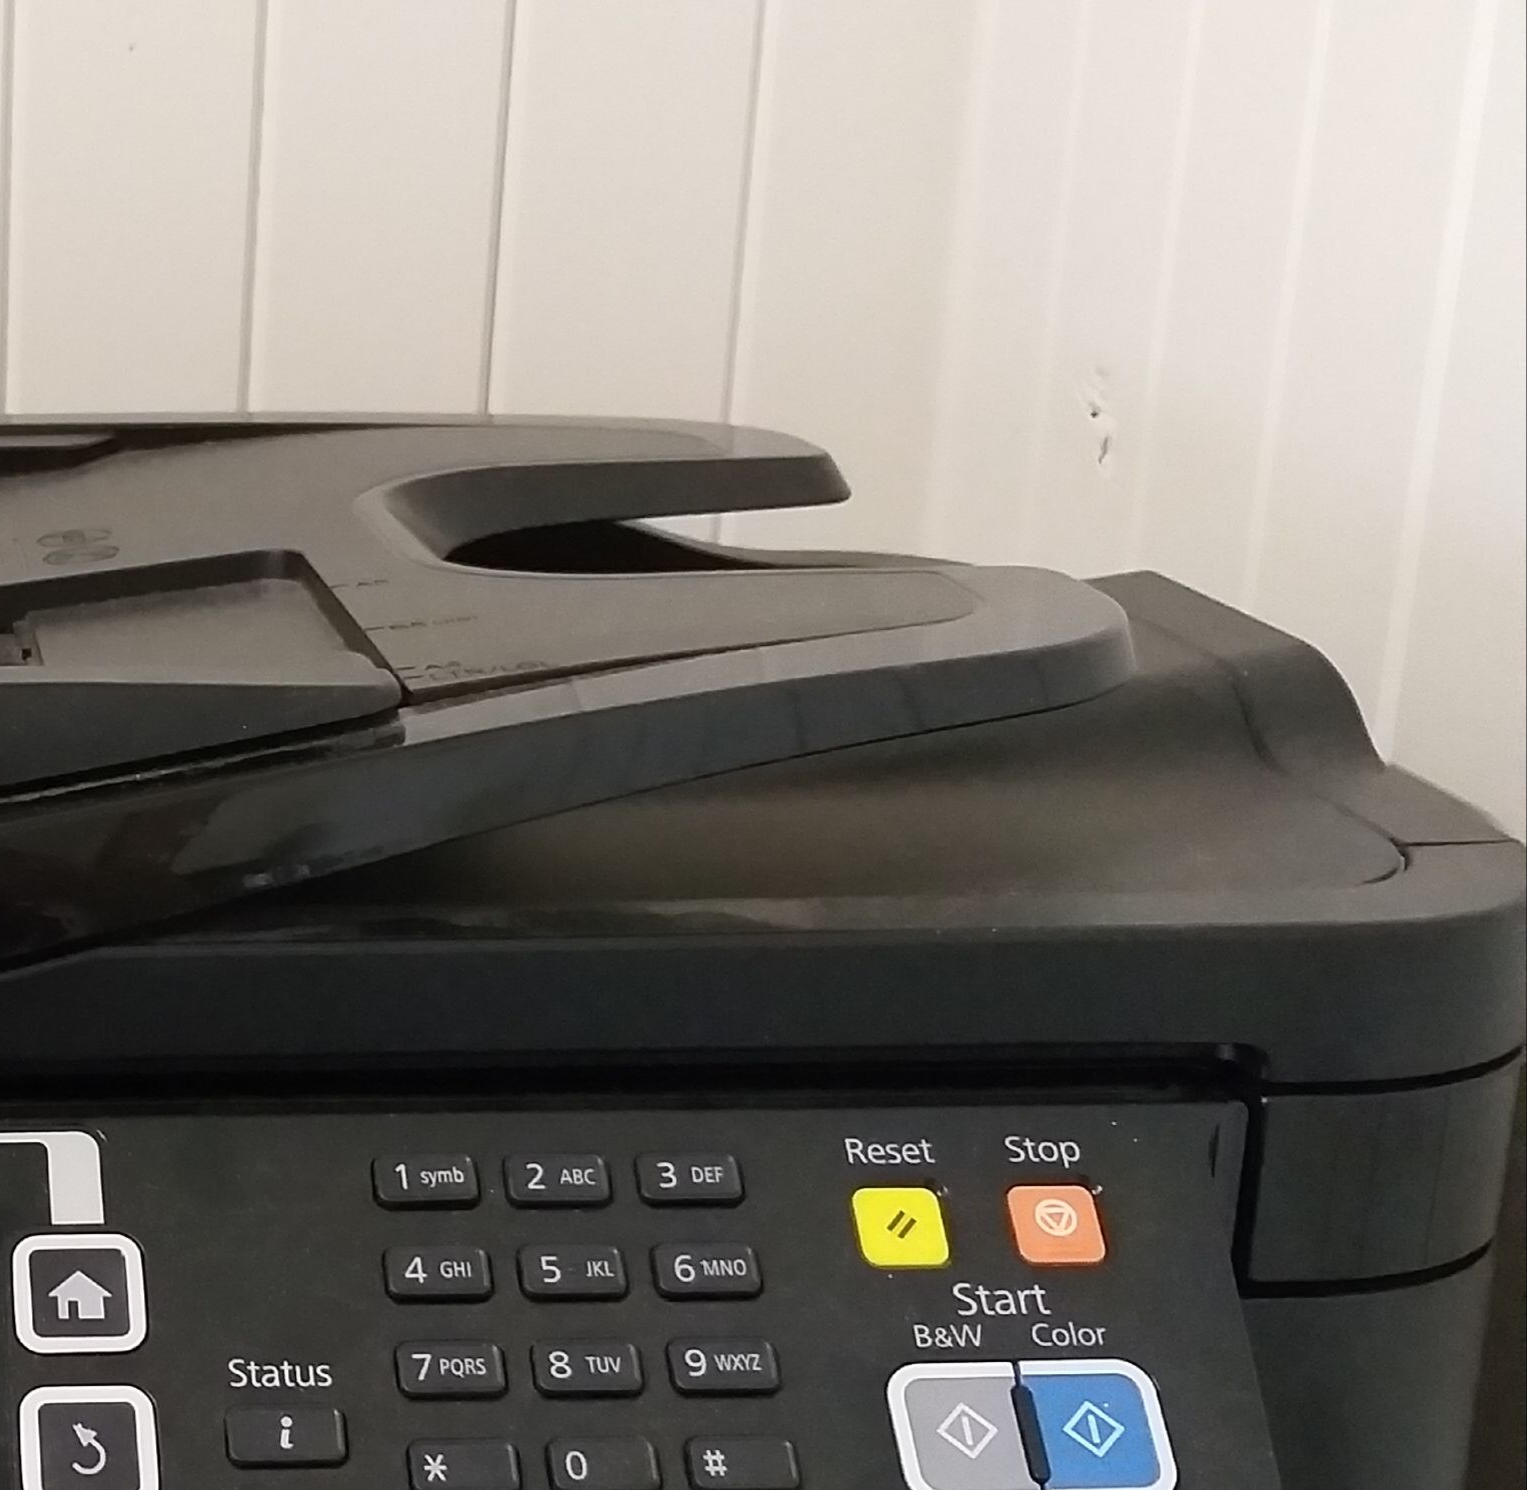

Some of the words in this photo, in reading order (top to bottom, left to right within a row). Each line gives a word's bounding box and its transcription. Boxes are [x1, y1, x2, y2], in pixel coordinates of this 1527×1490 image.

[844, 1138, 936, 1164] Reset
[1004, 1136, 1081, 1169] Stop
[395, 1163, 408, 1190] 1
[420, 1166, 465, 1188] symb
[526, 1163, 546, 1190] 2
[560, 1168, 596, 1185] ABC
[656, 1161, 677, 1188] 3
[691, 1166, 723, 1183] DEF
[404, 1256, 428, 1284] 4
[439, 1261, 472, 1279] GHI
[540, 1255, 562, 1283] 5
[586, 1260, 615, 1277] JKL
[674, 1254, 696, 1283] 6
[703, 1258, 747, 1276] MNO
[952, 1282, 1051, 1316] Start
[913, 1323, 982, 1348] B&W
[1031, 1321, 1106, 1347] Color
[228, 1358, 333, 1388] Status
[411, 1353, 432, 1381] 7
[439, 1358, 487, 1378] PQRS
[548, 1350, 572, 1379] 8
[584, 1356, 621, 1373] TUV
[684, 1349, 707, 1377] 9
[713, 1353, 763, 1371] WXYZ
[565, 1450, 588, 1480] 0
[702, 1449, 728, 1477] #
